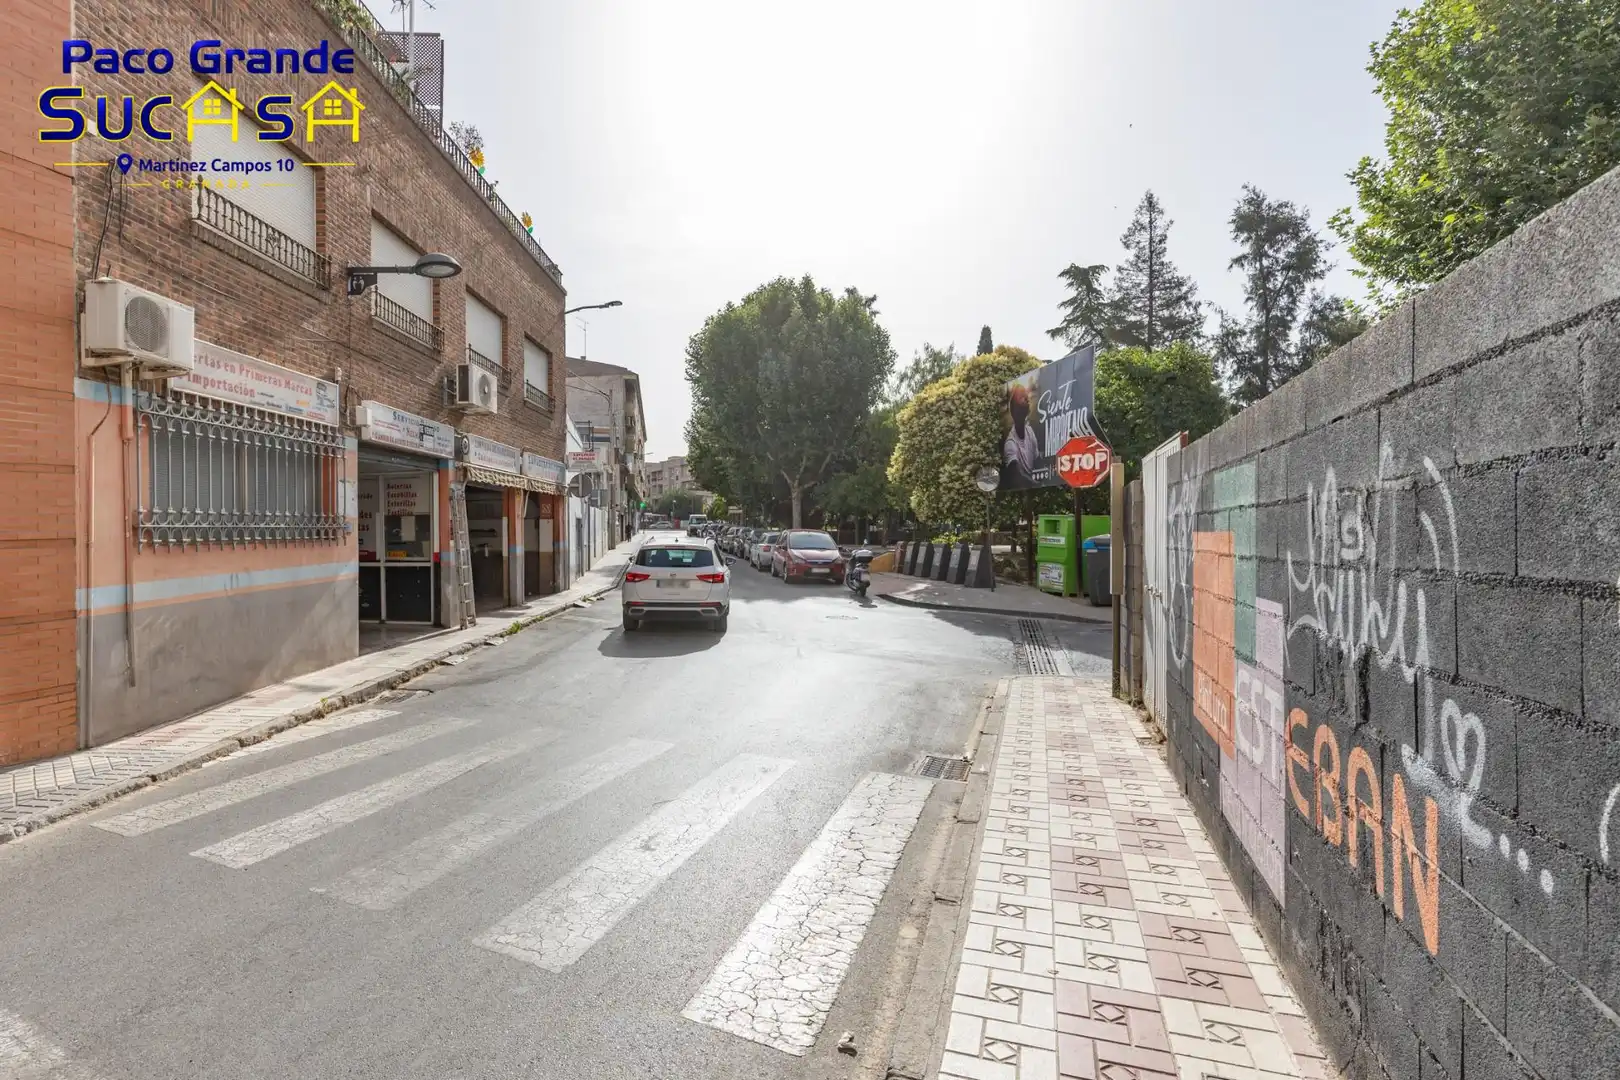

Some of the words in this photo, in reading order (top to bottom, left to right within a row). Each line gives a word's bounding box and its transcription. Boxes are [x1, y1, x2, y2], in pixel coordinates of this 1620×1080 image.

[239, 363, 282, 388] Primeras
[1037, 379, 1077, 424] Siente
[1060, 451, 1107, 473] STOP
